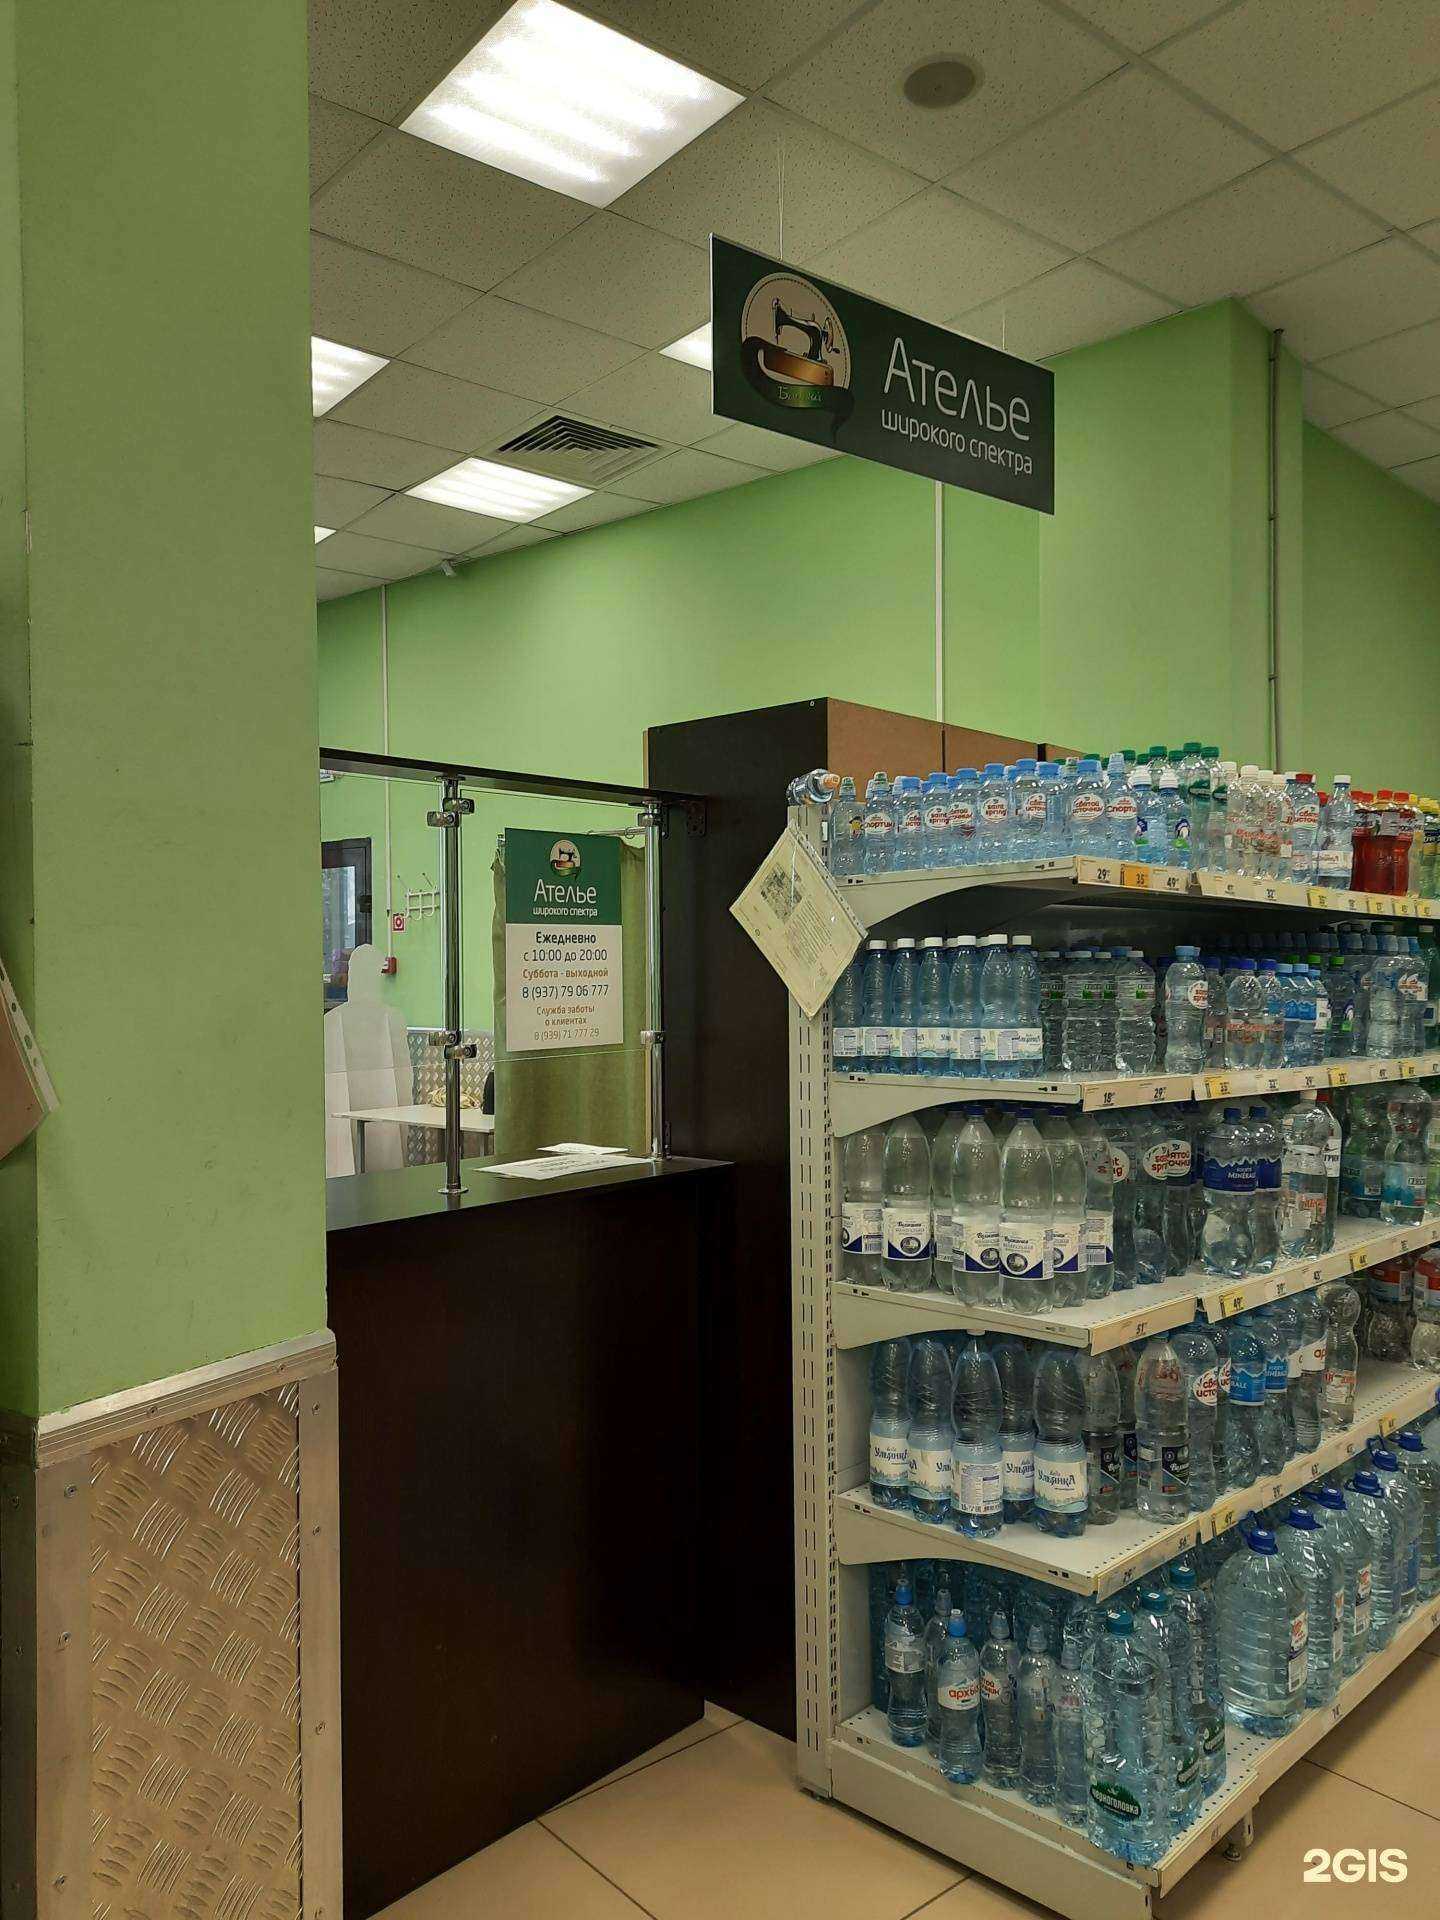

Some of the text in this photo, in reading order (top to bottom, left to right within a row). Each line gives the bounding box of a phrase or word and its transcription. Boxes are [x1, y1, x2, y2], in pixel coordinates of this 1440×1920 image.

[884, 337, 1030, 441] Ателье
[881, 408, 1033, 477] широкого спектра
[533, 878, 597, 904] Ателье
[533, 906, 598, 919] широкого спектра
[535, 931, 597, 946] Ежедневно
[523, 949, 608, 963] с 10:00 до 20:00
[522, 968, 558, 980] Суббота
[565, 968, 609, 979] выходной
[522, 984, 609, 1001] 8 (937) 79 06 777
[536, 1005, 595, 1017] Служба заботы
[551, 1017, 587, 1026] клиентах
